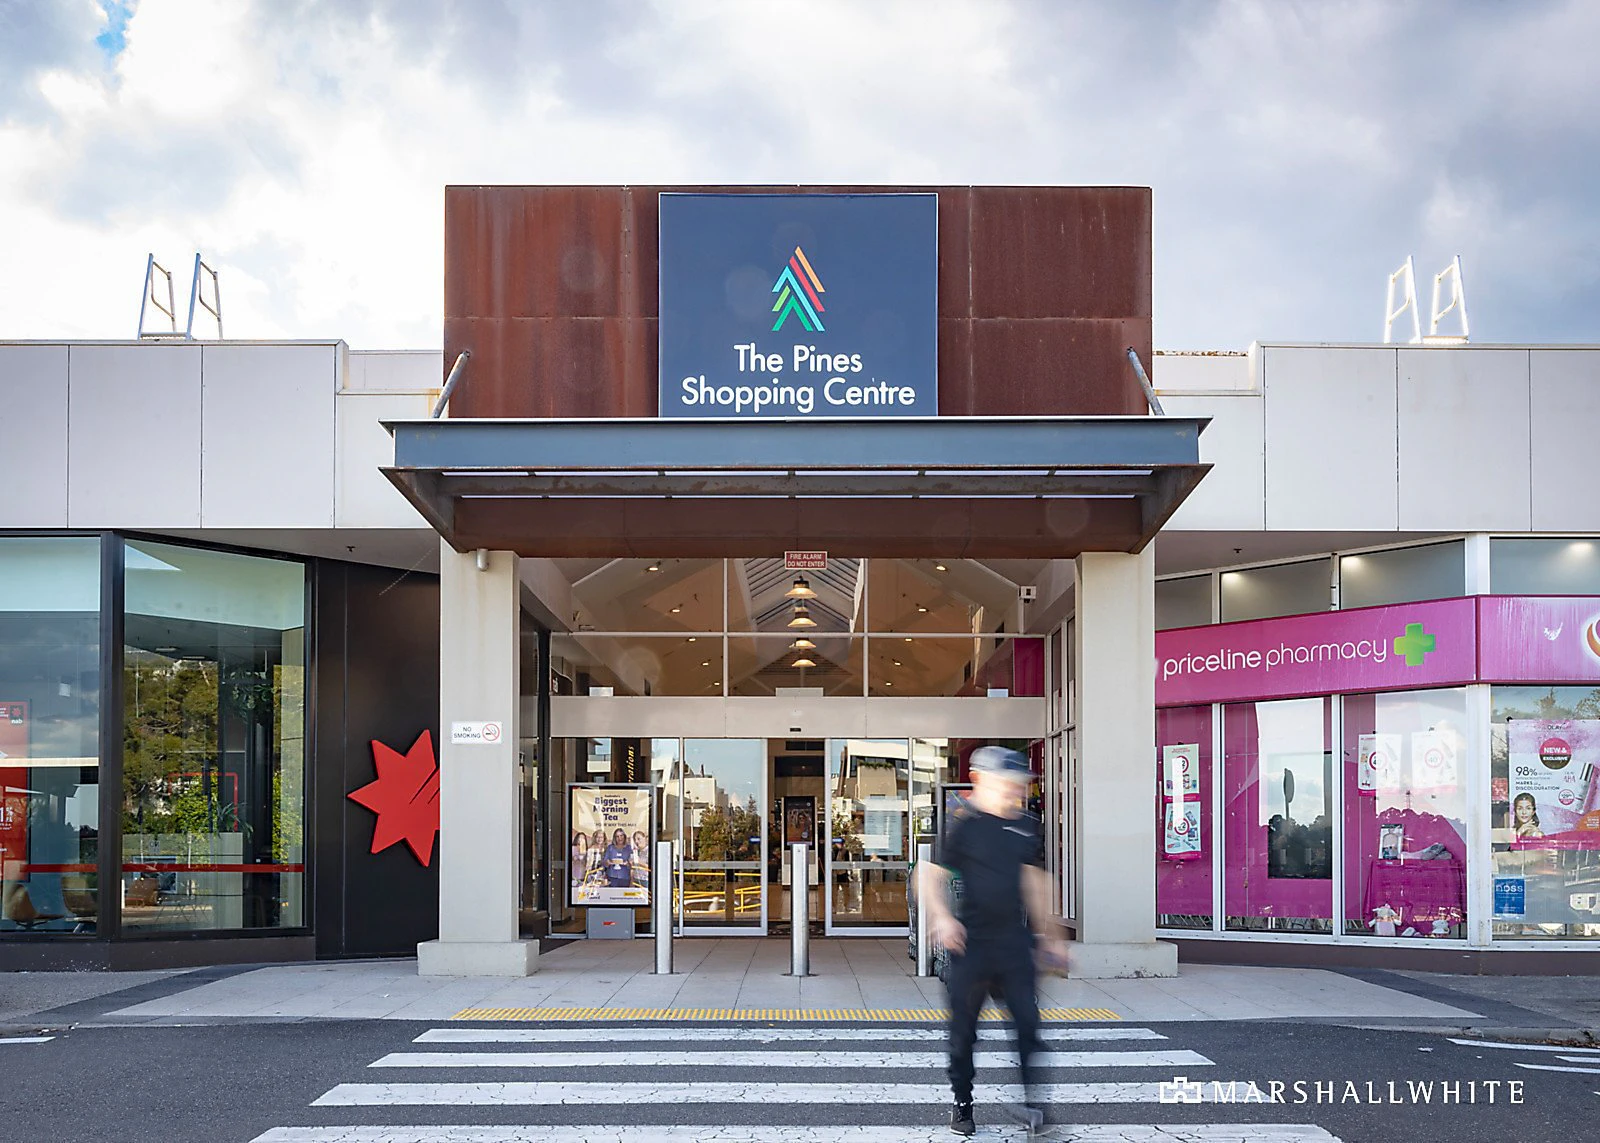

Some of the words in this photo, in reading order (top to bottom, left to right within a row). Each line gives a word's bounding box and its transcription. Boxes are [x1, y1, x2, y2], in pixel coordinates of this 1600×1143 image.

[733, 342, 784, 372] The
[793, 344, 863, 373] Pines
[681, 375, 814, 413] Shopping
[823, 376, 916, 405] Centre
[1163, 648, 1262, 681] priceline
[1265, 638, 1387, 672] pharmacy
[1515, 766, 1538, 776] 98%
[594, 797, 628, 806] Biggest
[603, 813, 618, 821] Tea
